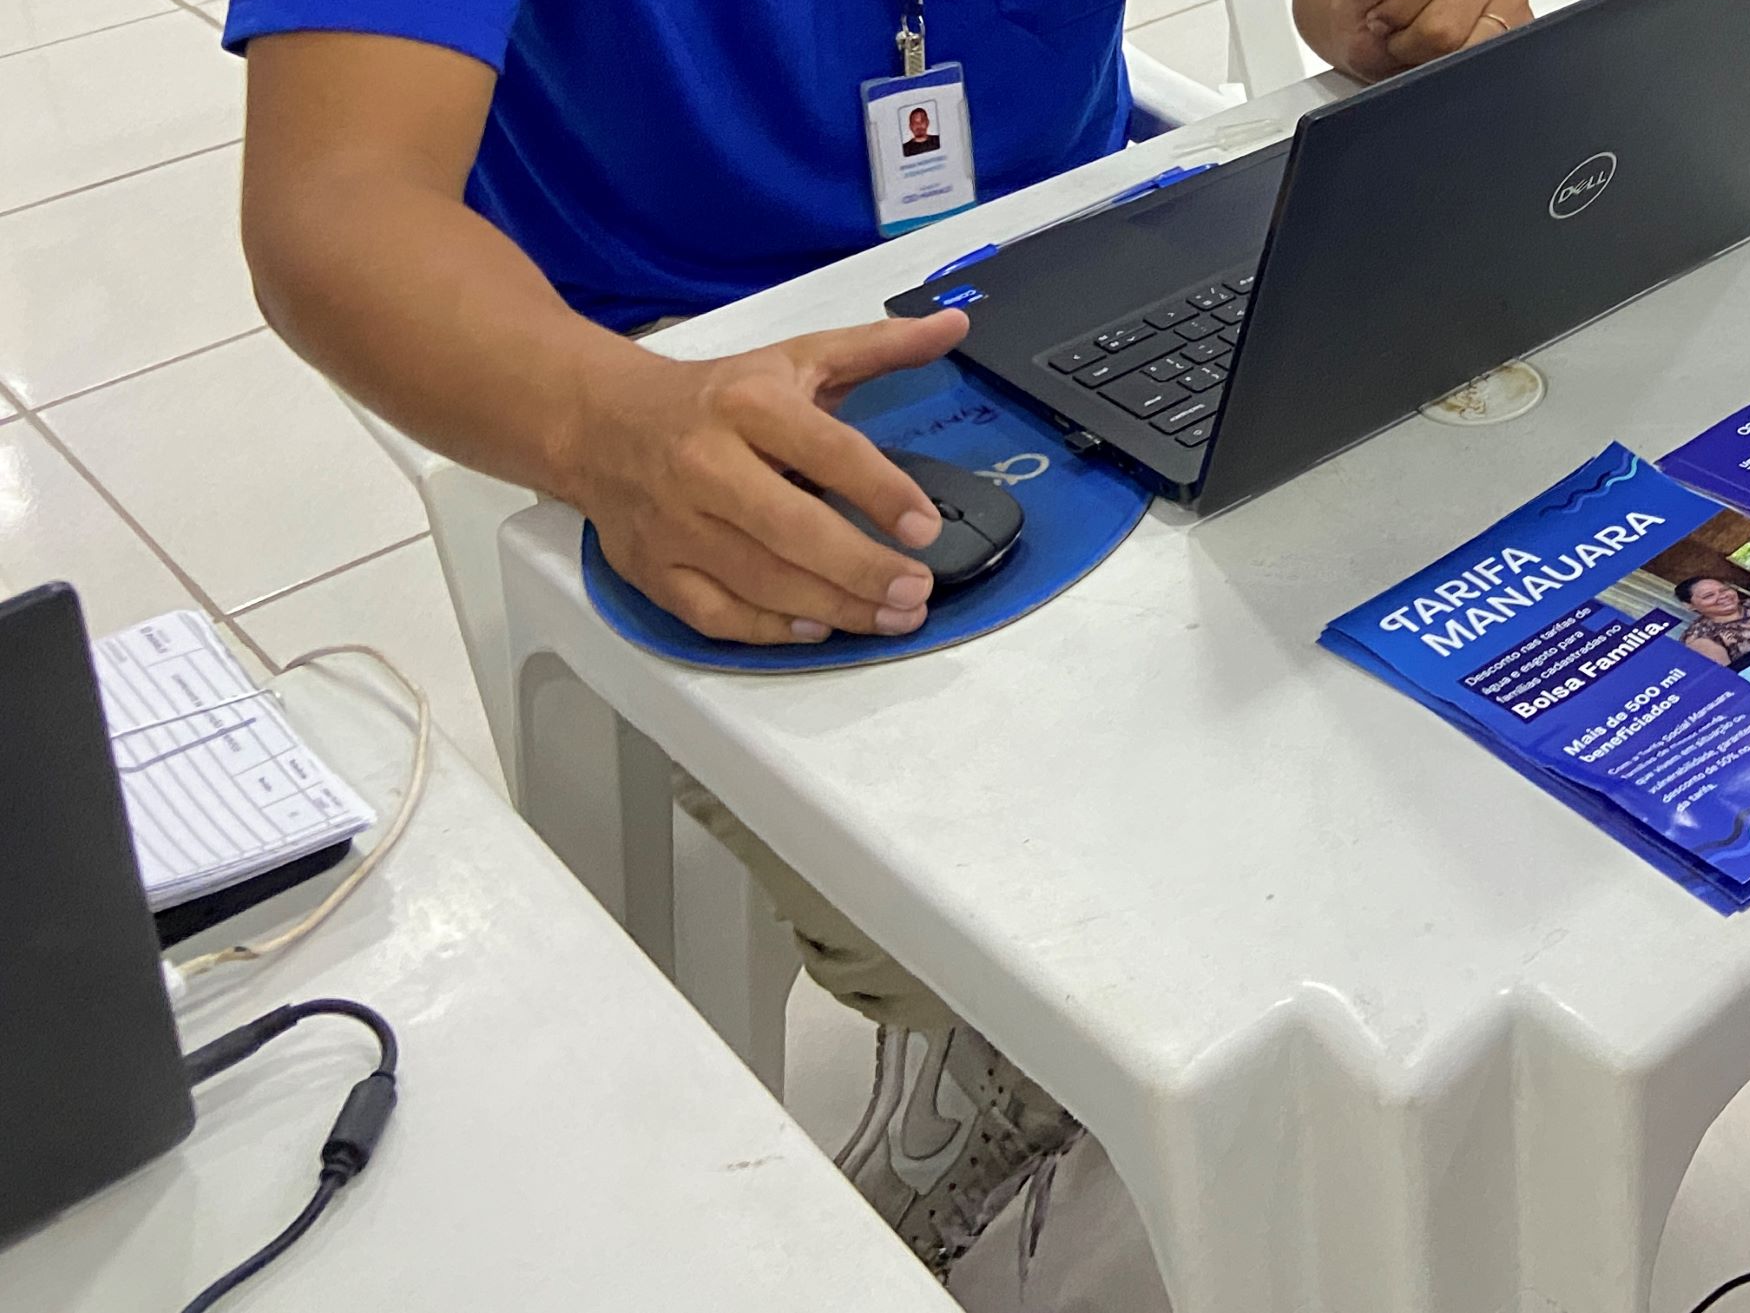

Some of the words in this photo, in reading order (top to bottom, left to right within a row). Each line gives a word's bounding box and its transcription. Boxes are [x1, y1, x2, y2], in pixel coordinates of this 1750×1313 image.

[1557, 170, 1606, 204] DELL
[1379, 547, 1541, 632] TARIFA
[1420, 512, 1665, 656] MANAUARA
[1464, 651, 1520, 686] Desconto
[1520, 638, 1541, 653] nas
[1539, 617, 1576, 640] tarifas
[1575, 607, 1591, 618] de
[1481, 676, 1511, 694] água
[1510, 670, 1520, 678] e
[1519, 647, 1558, 672] esgoto
[1557, 630, 1584, 650] para
[1495, 677, 1541, 703] famílias
[1540, 634, 1606, 678] cadastradas
[1605, 624, 1621, 636] no
[1511, 677, 1585, 718] Bolsa
[1578, 622, 1669, 677] Família.
[1563, 726, 1607, 756] Mais
[1606, 711, 1628, 728] de
[1624, 686, 1660, 712] 500
[1659, 667, 1686, 688] mil
[1578, 694, 1680, 762] beneficiados
[1661, 719, 1691, 742] Social
[1662, 772, 1705, 803] desconto
[1704, 764, 1718, 774] de
[1715, 752, 1739, 767] 50%
